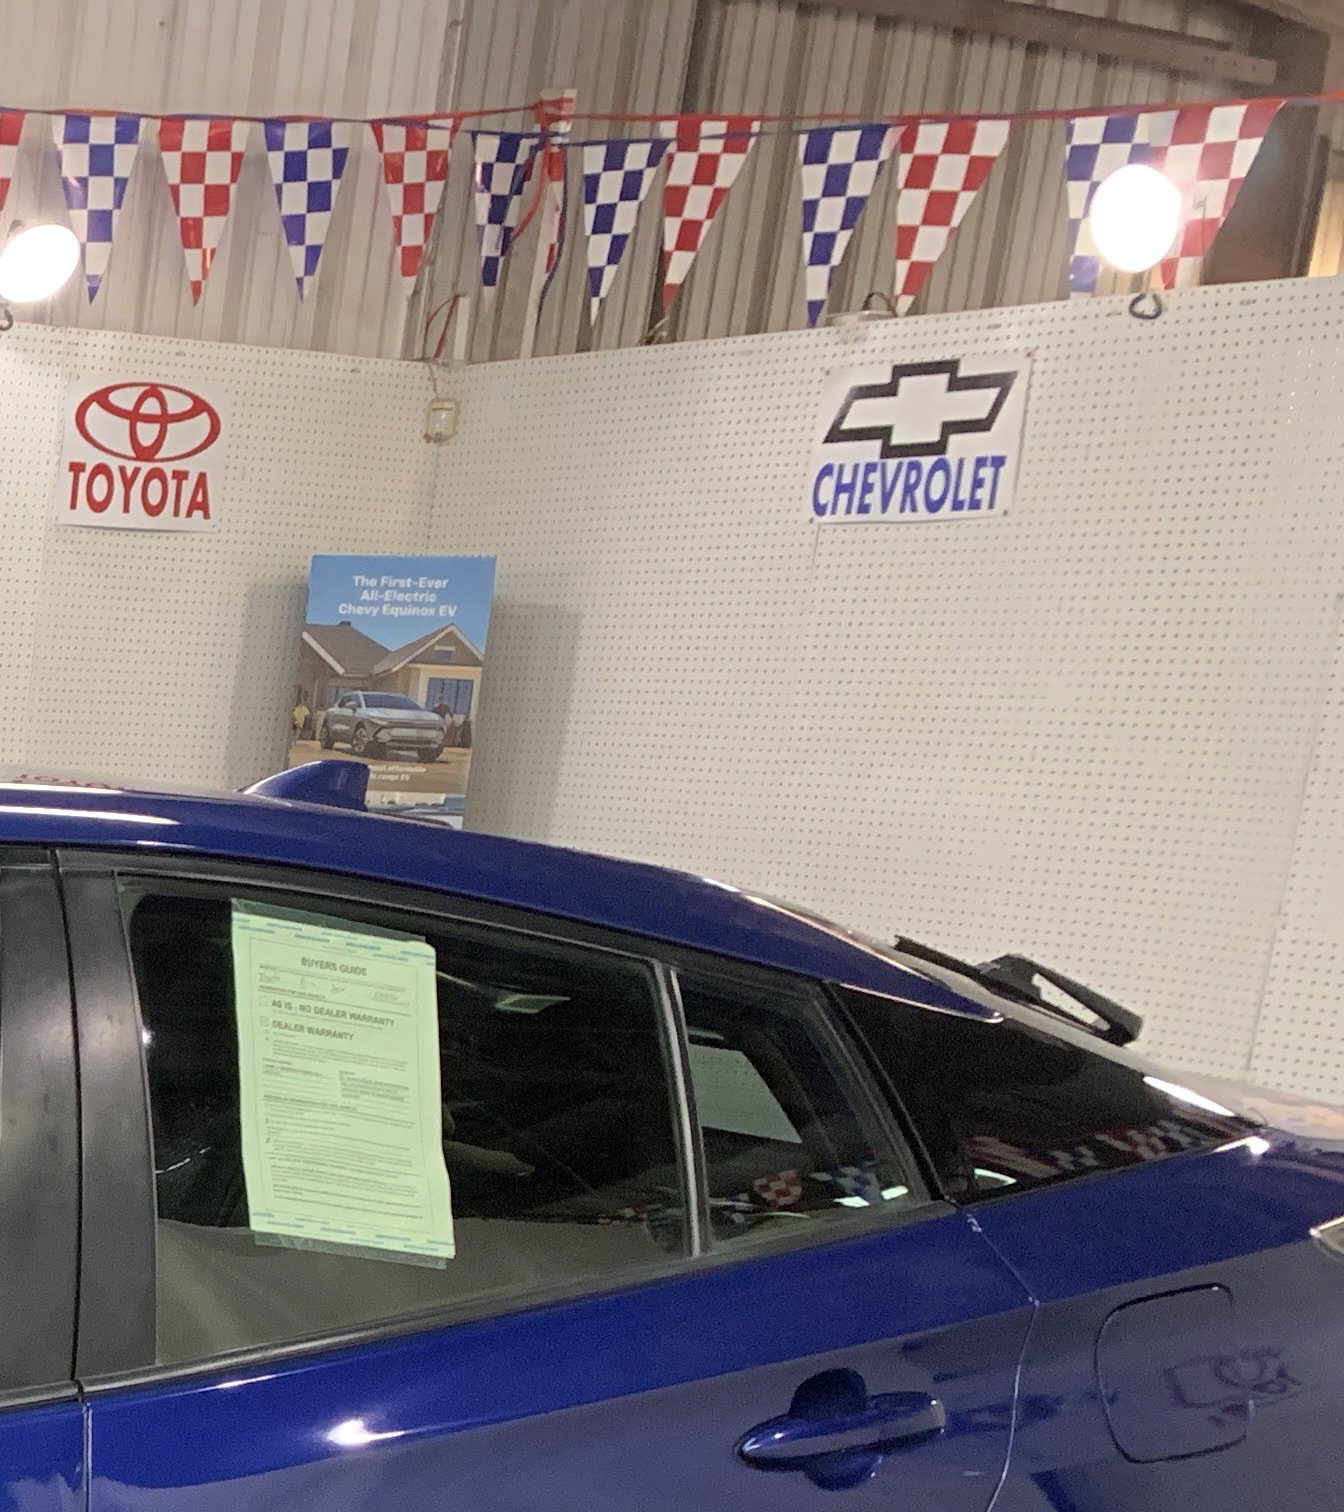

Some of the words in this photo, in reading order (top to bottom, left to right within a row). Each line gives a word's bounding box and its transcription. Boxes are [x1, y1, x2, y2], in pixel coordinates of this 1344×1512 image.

[68, 460, 212, 520] TOYOTA
[812, 454, 1006, 518] CHEVROLET
[353, 575, 377, 588] The
[380, 576, 450, 589] First-Ever
[360, 589, 438, 603] All-Electric
[338, 603, 379, 617] Chevy
[382, 604, 435, 618] Equinox
[439, 604, 458, 617] EV
[300, 956, 338, 972] BUYERS
[339, 964, 368, 977] GUIDE
[272, 999, 282, 1009] AS
[299, 1004, 312, 1014] NO
[314, 1006, 348, 1019] DEALER
[349, 1012, 395, 1027] WARRANTY
[272, 1019, 305, 1034] DEALER
[307, 1026, 355, 1041] WARRANTY
